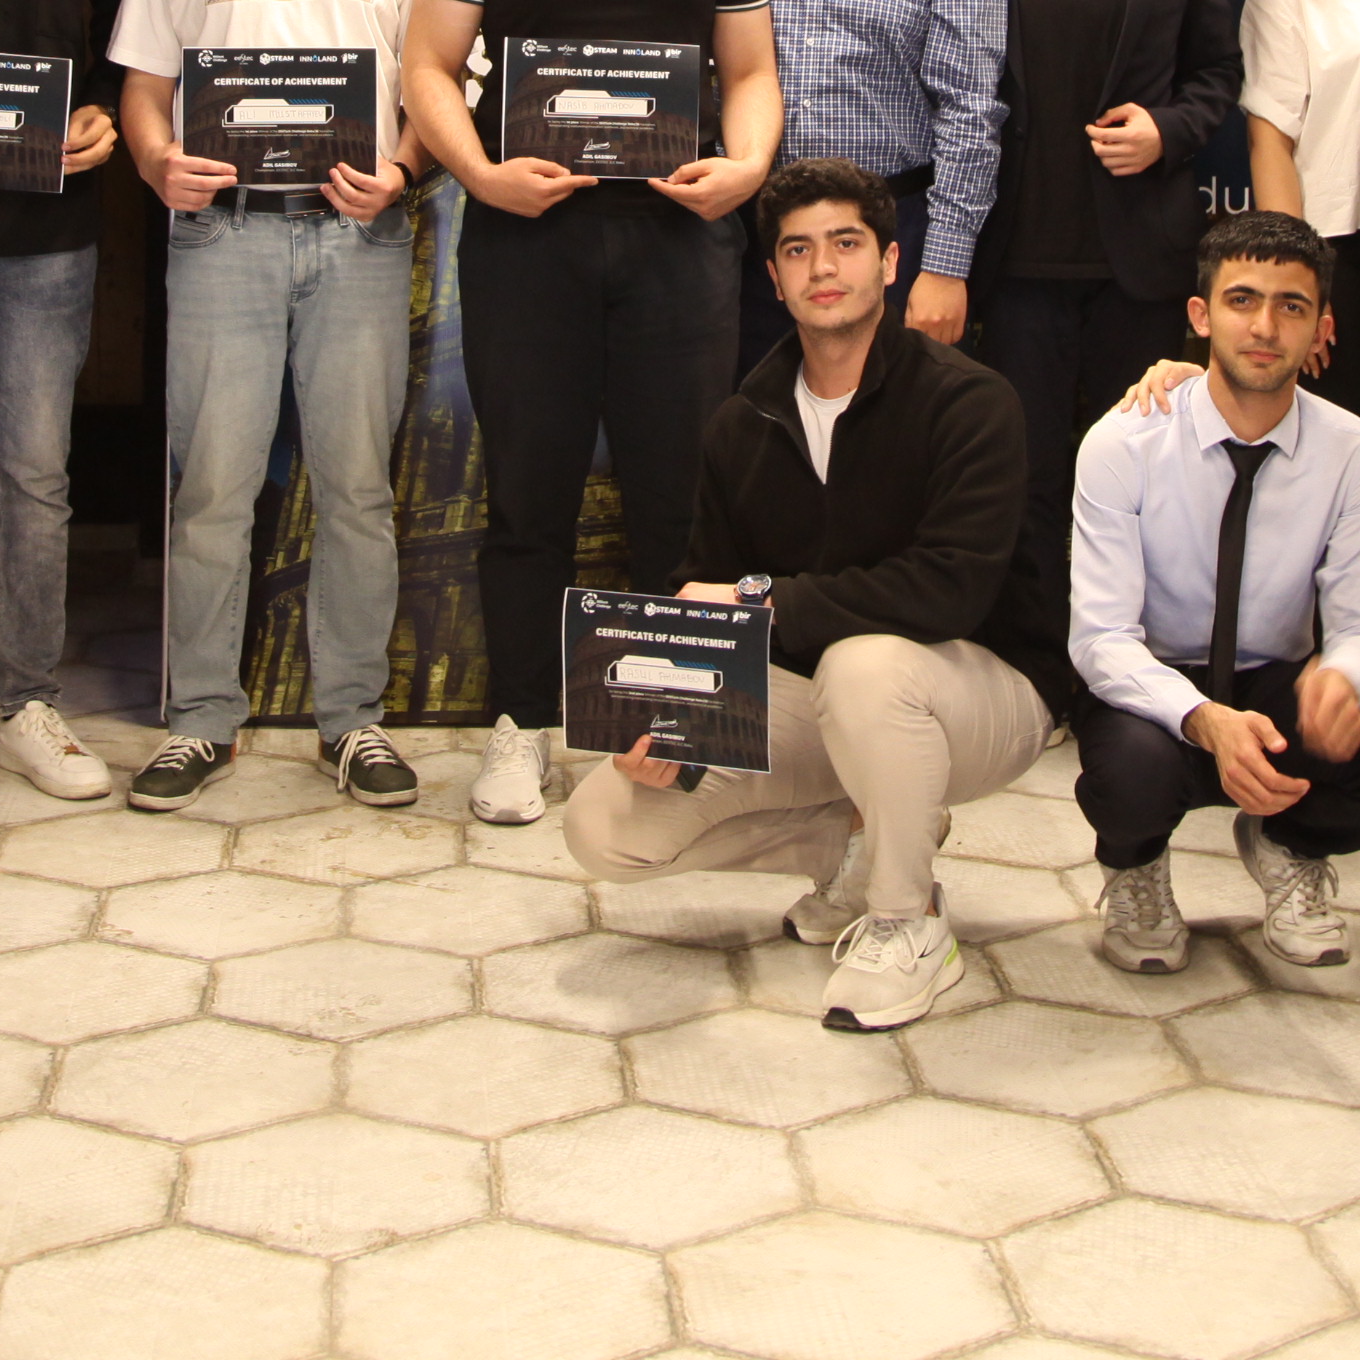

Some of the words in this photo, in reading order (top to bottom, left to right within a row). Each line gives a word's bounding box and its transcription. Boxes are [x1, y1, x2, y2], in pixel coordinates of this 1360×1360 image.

[300, 55, 337, 63] INNOLAND
[537, 68, 593, 77] CERTIFICATE
[594, 69, 607, 77] OF
[607, 69, 670, 79] ACHIEVEMENT
[214, 78, 270, 86] CERTIFICATE
[271, 78, 283, 86] OF
[284, 78, 348, 86] ACHIEVEMENT
[655, 606, 681, 615] STEAM
[687, 609, 728, 620] INNOLAND
[596, 627, 654, 641] CERTIFICATE
[655, 633, 668, 642] OF
[669, 635, 736, 650] ACHIEVEMENT
